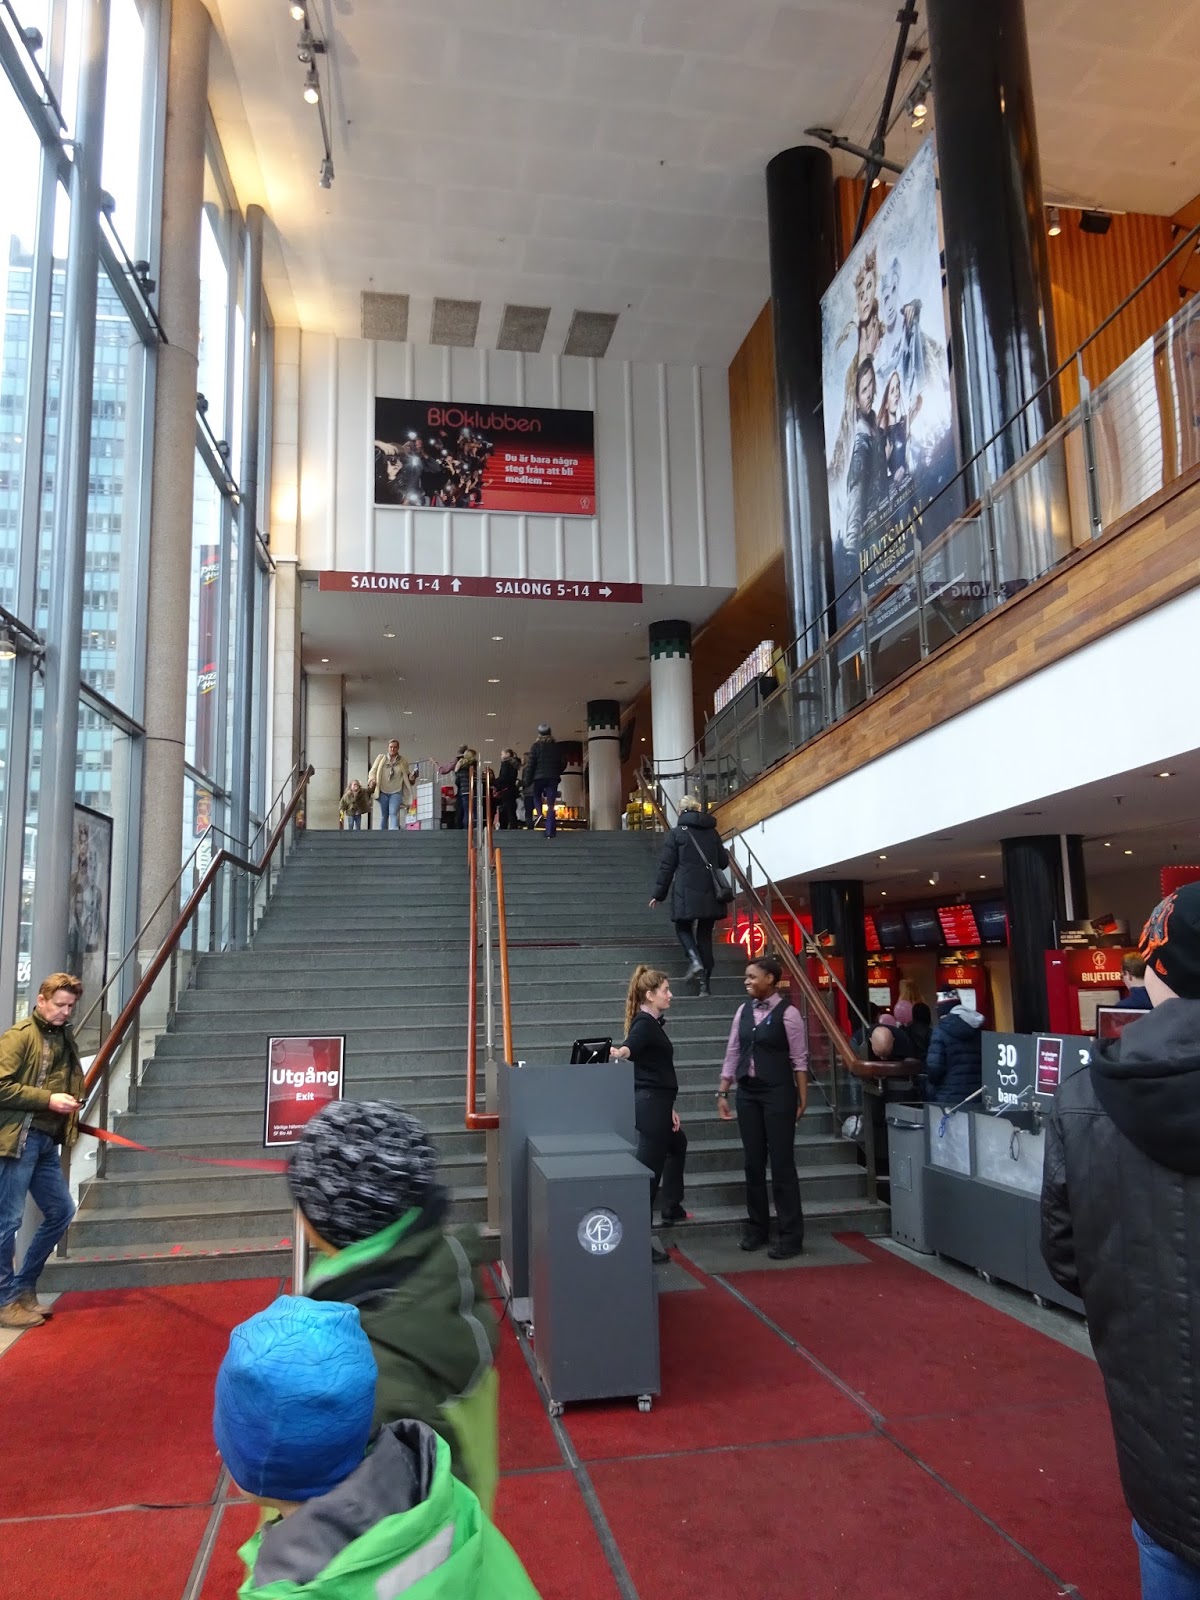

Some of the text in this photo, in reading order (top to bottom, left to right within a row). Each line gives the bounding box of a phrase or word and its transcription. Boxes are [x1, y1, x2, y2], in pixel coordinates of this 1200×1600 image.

[427, 407, 542, 432] BIOklubben
[505, 454, 578, 467] Du är bara några
[505, 464, 573, 476] steg från att bli
[351, 576, 440, 591] SALONG 1-4
[496, 582, 590, 597] SALONG 5-14
[1081, 971, 1121, 983] BILJETTER
[997, 1044, 1017, 1067] 3D
[272, 1067, 339, 1087] Utgång
[296, 1092, 314, 1101] Exit
[998, 1087, 1018, 1105] barn
